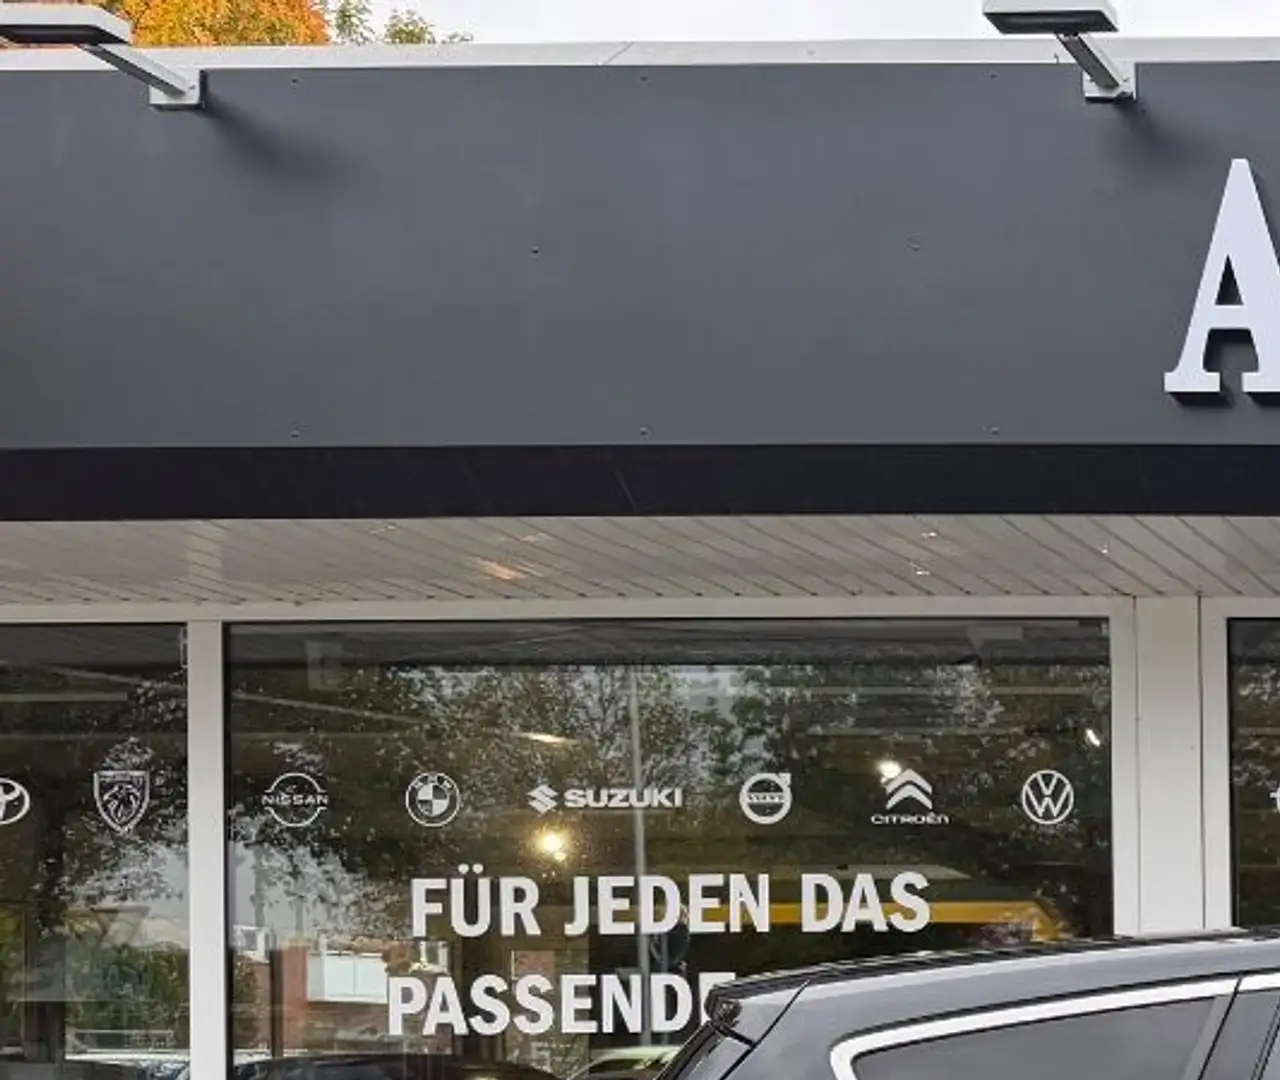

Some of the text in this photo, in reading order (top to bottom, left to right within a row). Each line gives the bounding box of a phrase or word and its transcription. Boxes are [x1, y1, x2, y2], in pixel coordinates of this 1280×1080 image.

[262, 794, 328, 806] NISSAN
[565, 788, 682, 809] SUZUKI
[412, 863, 930, 937] FÜR JEDEN DAS
